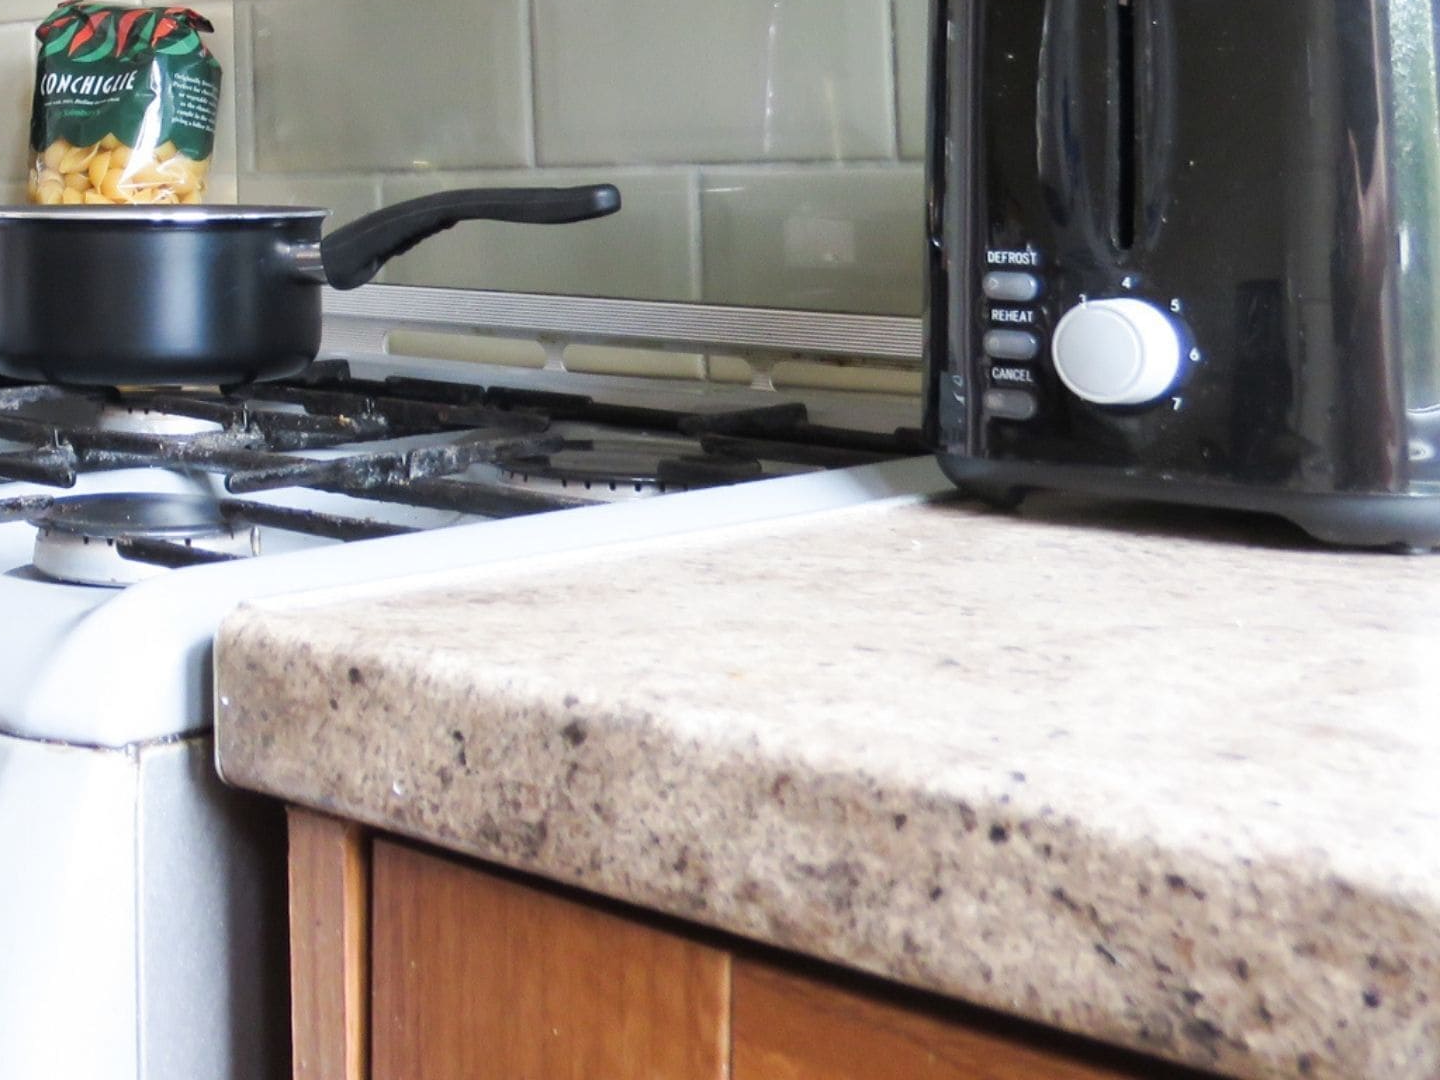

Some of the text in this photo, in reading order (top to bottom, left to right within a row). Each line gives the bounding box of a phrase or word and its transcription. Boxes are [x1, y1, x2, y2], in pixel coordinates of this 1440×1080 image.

[40, 69, 138, 96] CONCHIGLIE
[987, 251, 1038, 265] DEFROST
[1121, 276, 1132, 289] 4
[1170, 298, 1181, 312] 5
[991, 309, 1034, 323] REHEAT
[1189, 347, 1200, 361] 6
[991, 367, 1034, 382] CANCEL
[1171, 397, 1183, 410] 7
